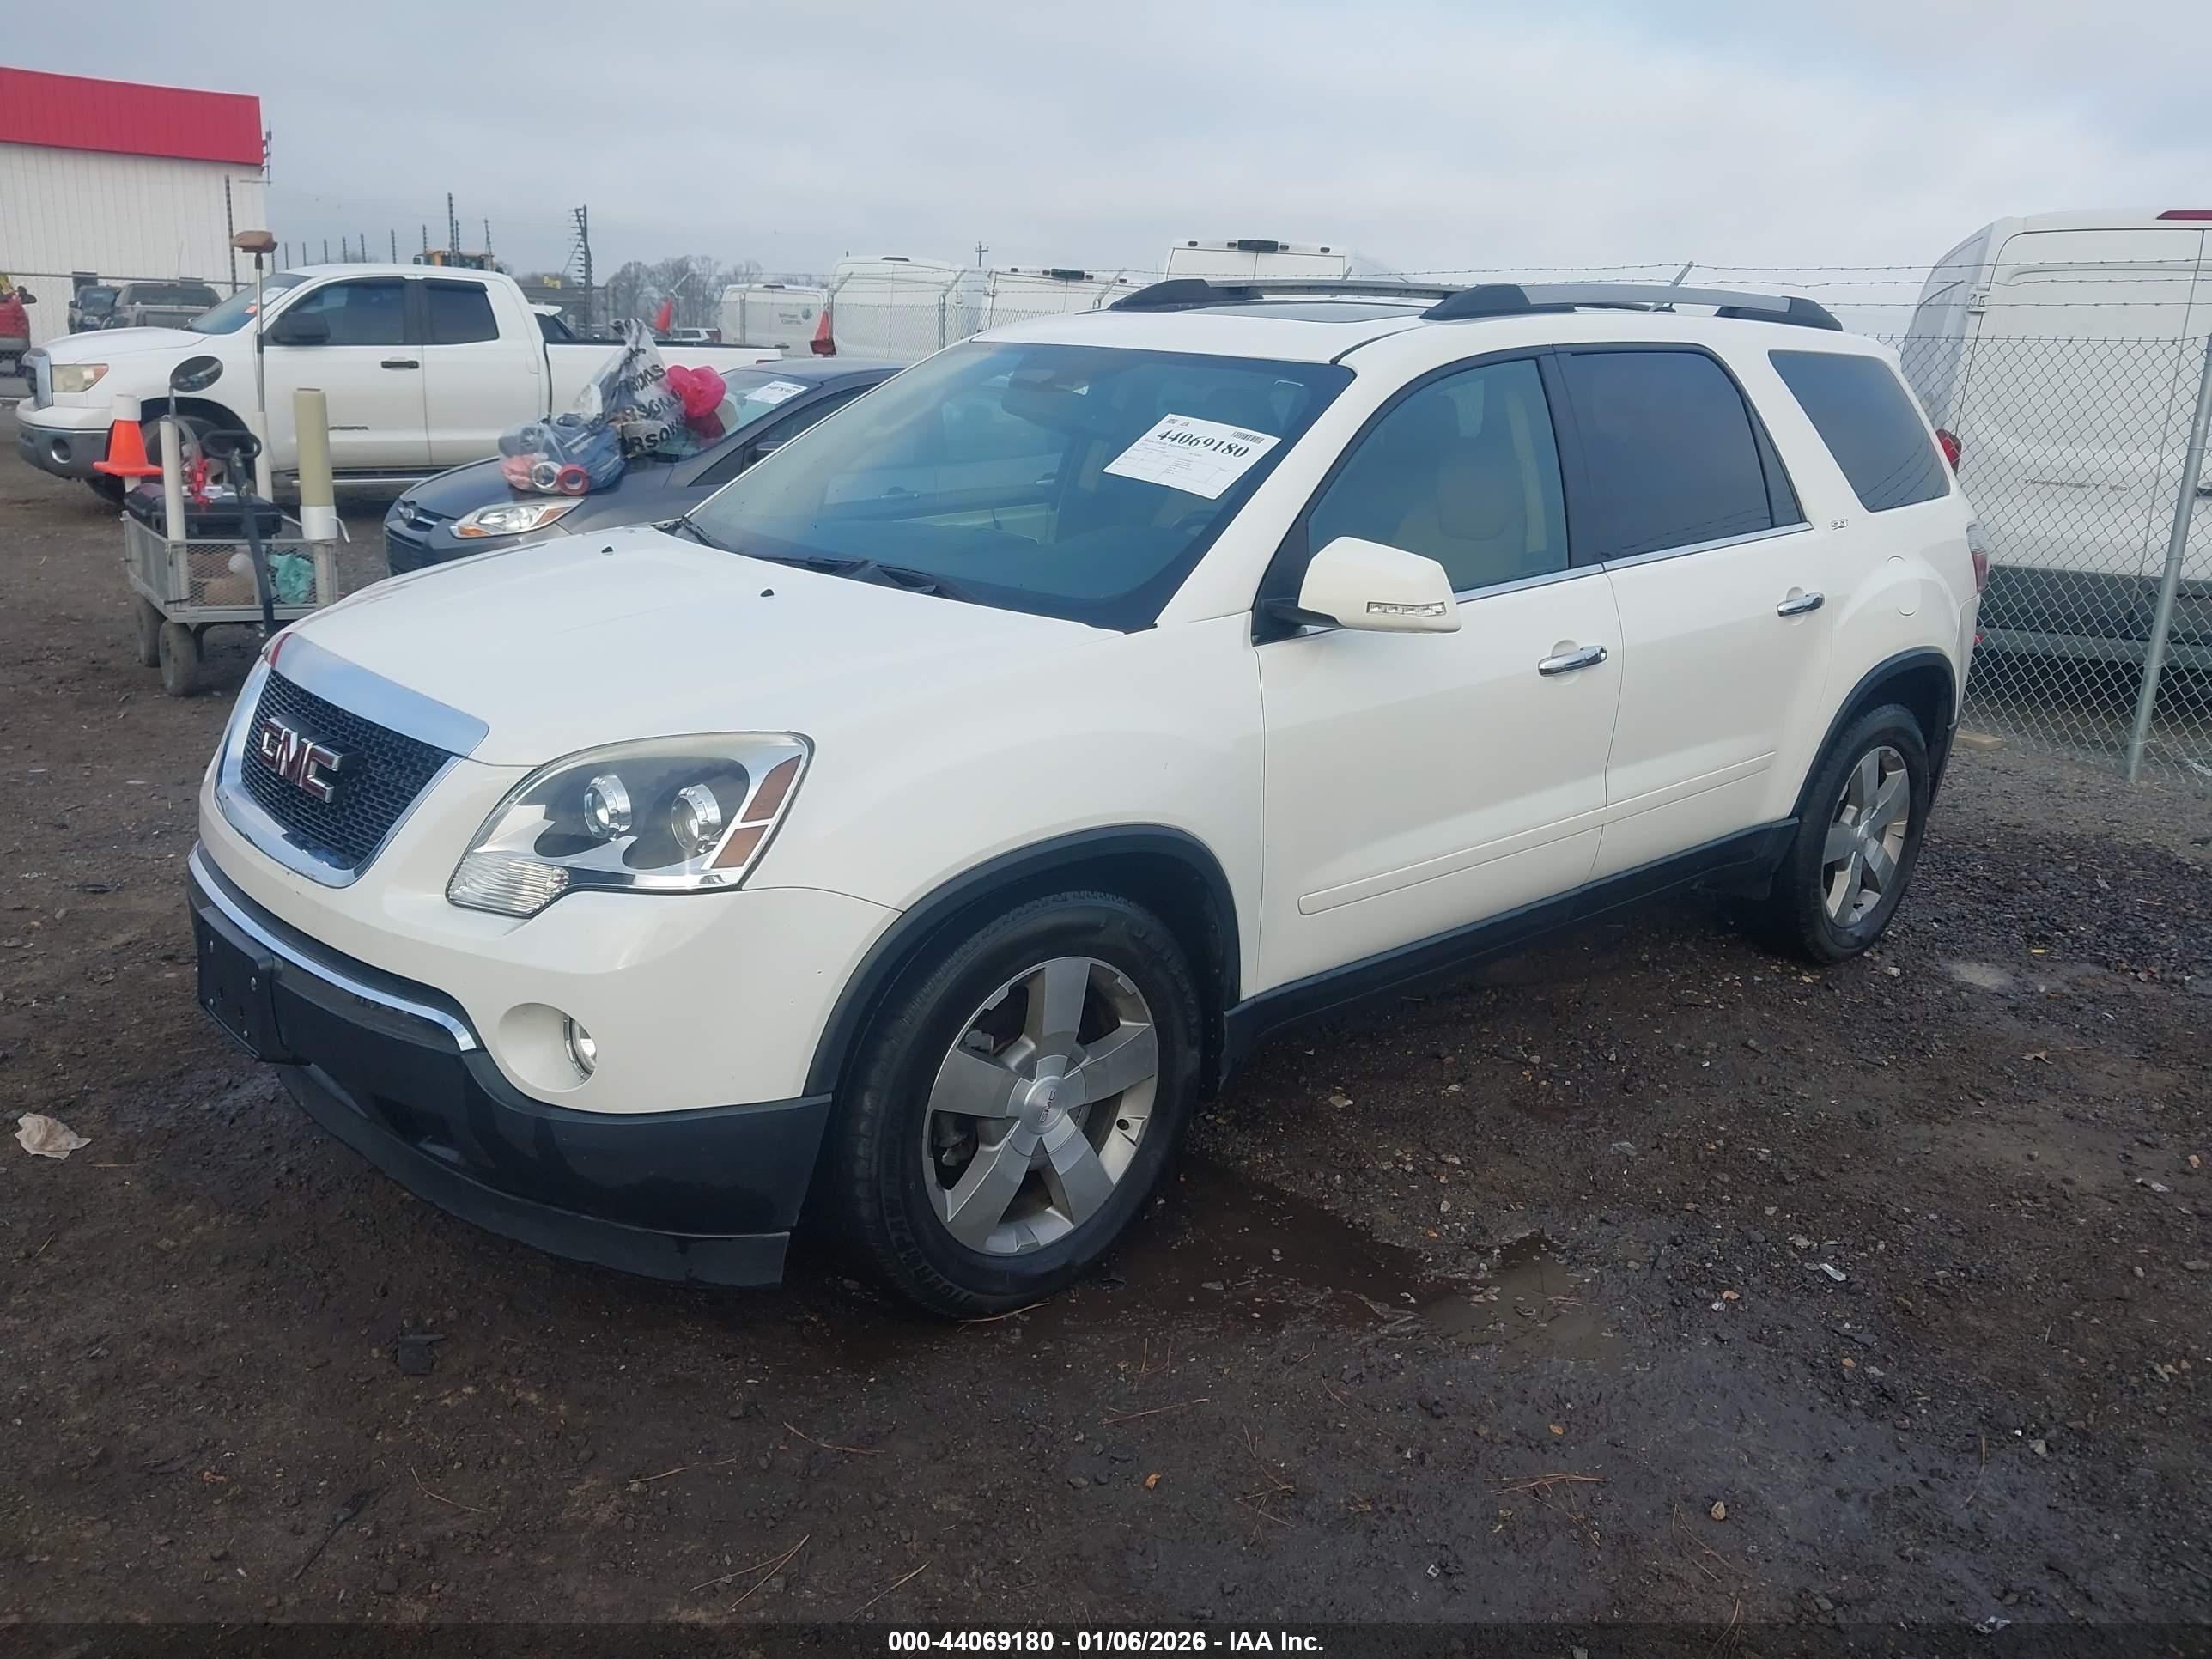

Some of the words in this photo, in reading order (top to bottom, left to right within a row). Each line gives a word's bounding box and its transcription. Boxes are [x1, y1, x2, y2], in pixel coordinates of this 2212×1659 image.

[1157, 429, 1249, 459] 44069180
[259, 718, 343, 804] GMC
[1039, 1089, 1057, 1123] GMC
